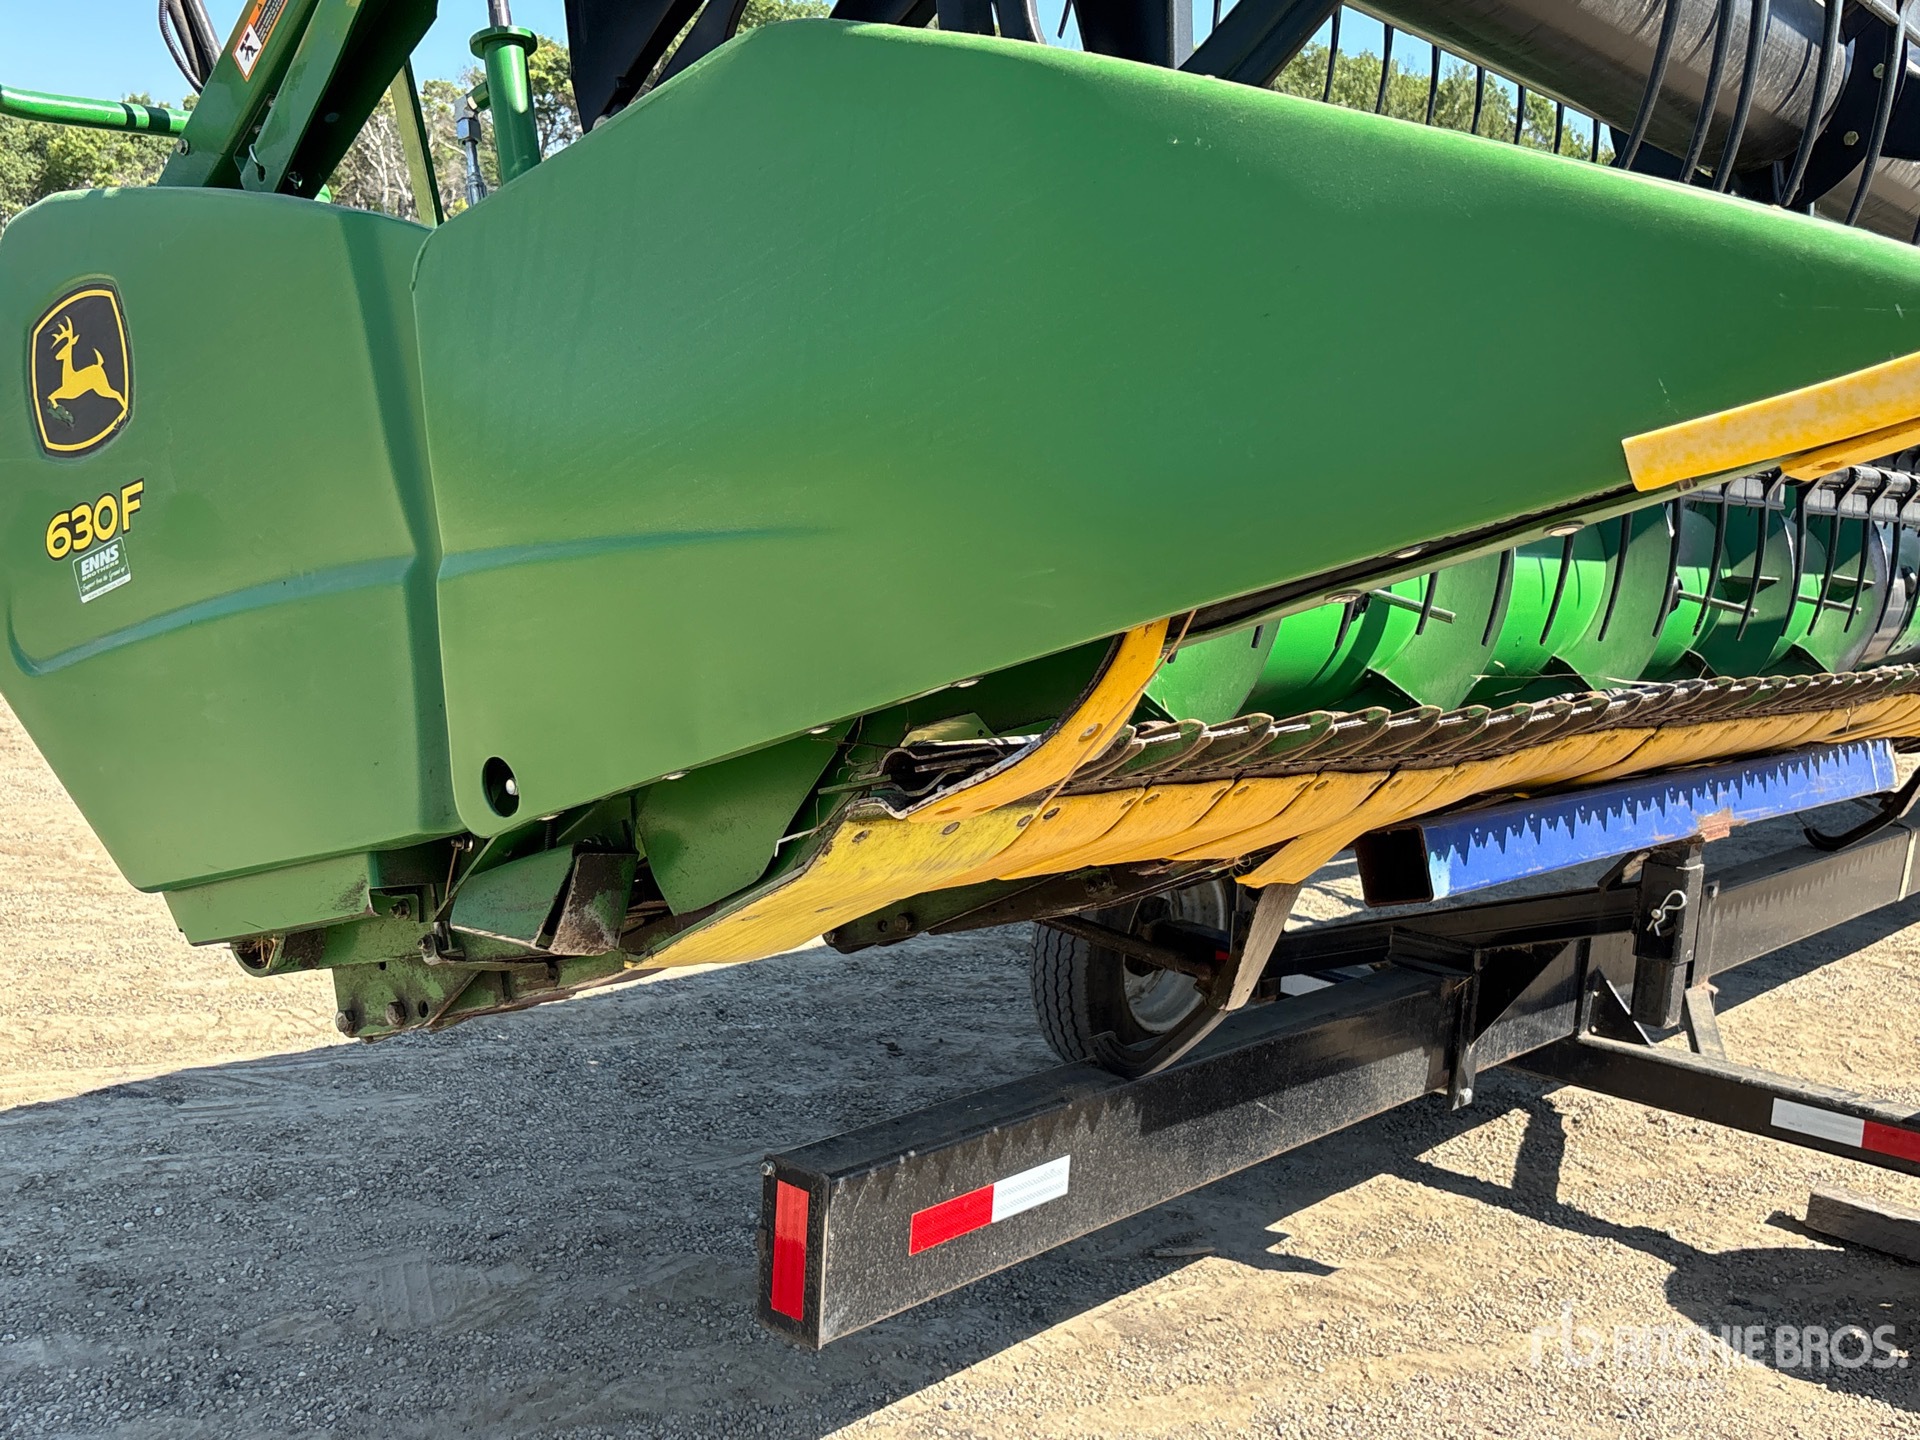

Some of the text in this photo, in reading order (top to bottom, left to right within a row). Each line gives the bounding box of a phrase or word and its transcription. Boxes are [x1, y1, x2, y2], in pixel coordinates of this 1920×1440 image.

[46, 478, 144, 561] 630F
[81, 544, 120, 576] ENNS
[81, 559, 120, 582] BROTHERS
